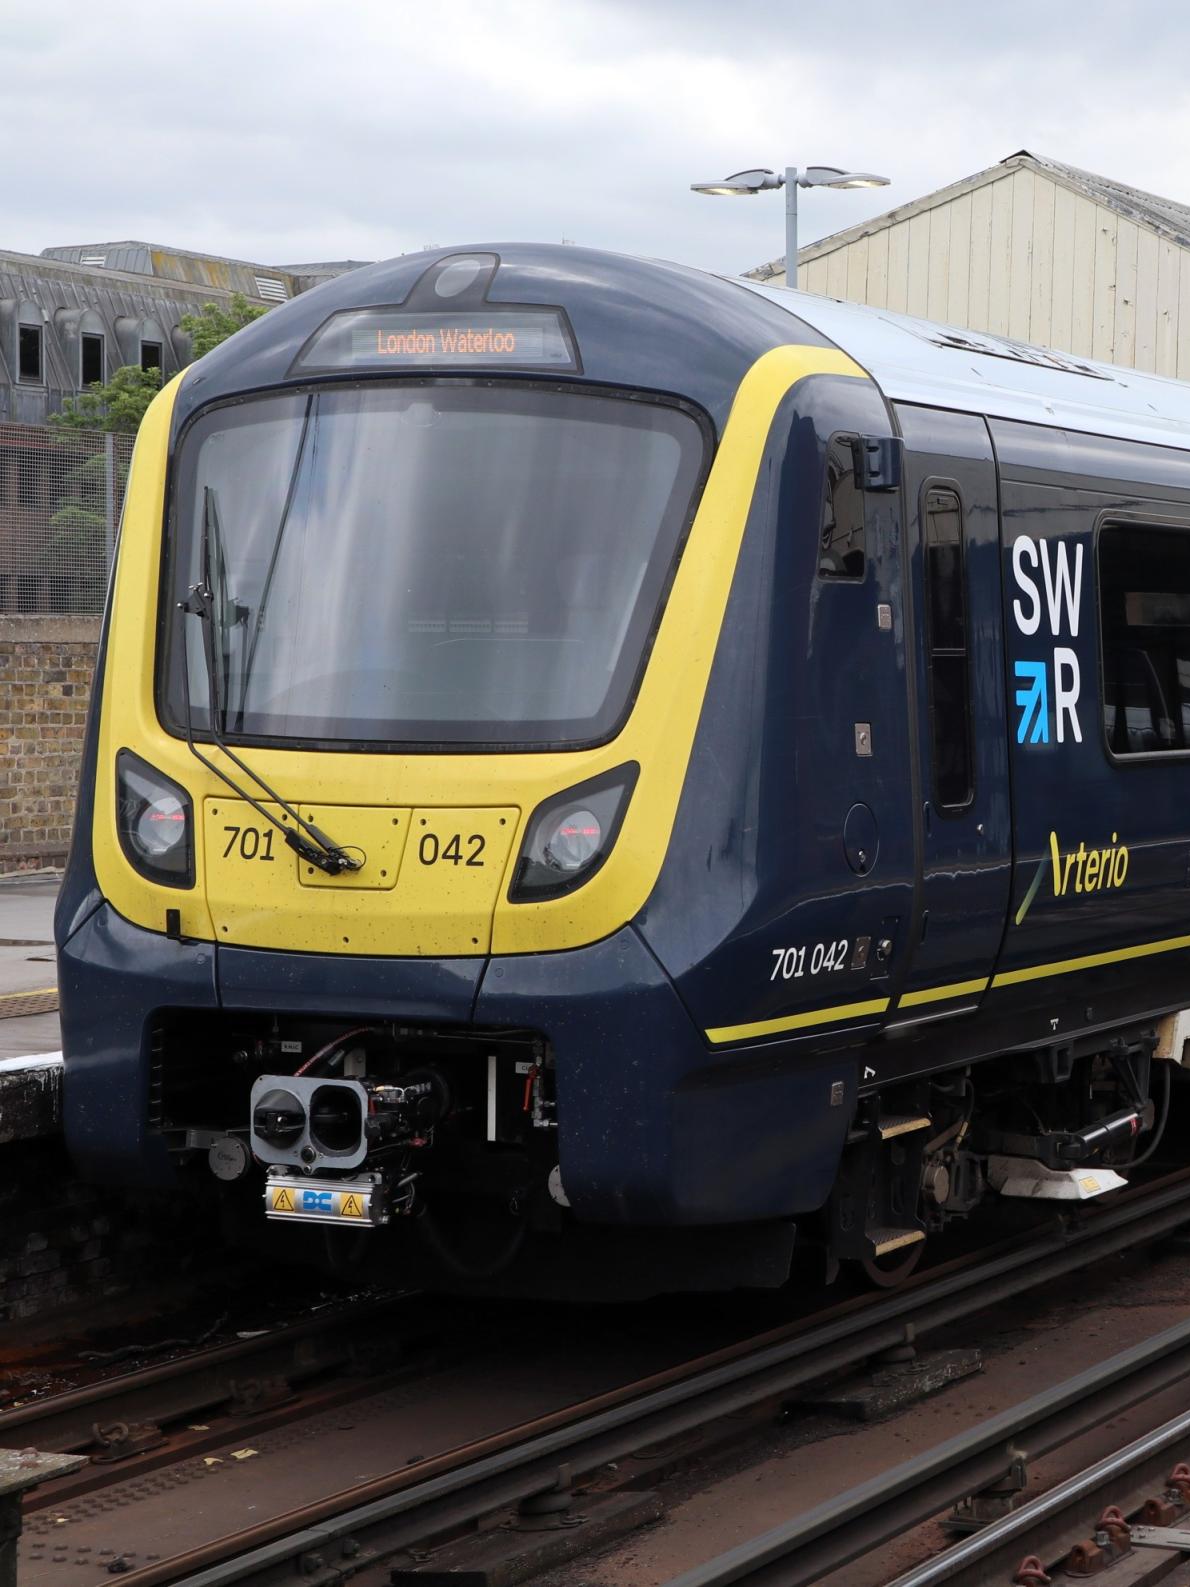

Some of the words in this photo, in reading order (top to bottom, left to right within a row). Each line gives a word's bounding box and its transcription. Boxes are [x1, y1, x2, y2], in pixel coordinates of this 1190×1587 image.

[376, 329, 435, 354] London
[440, 328, 517, 353] Waterloo
[1012, 535, 1084, 637] SW
[1053, 647, 1083, 744] R
[222, 826, 275, 861] 701
[418, 833, 486, 867] 042
[1018, 831, 1129, 922] Arterio
[770, 947, 806, 981] 701
[810, 939, 848, 975] 042
